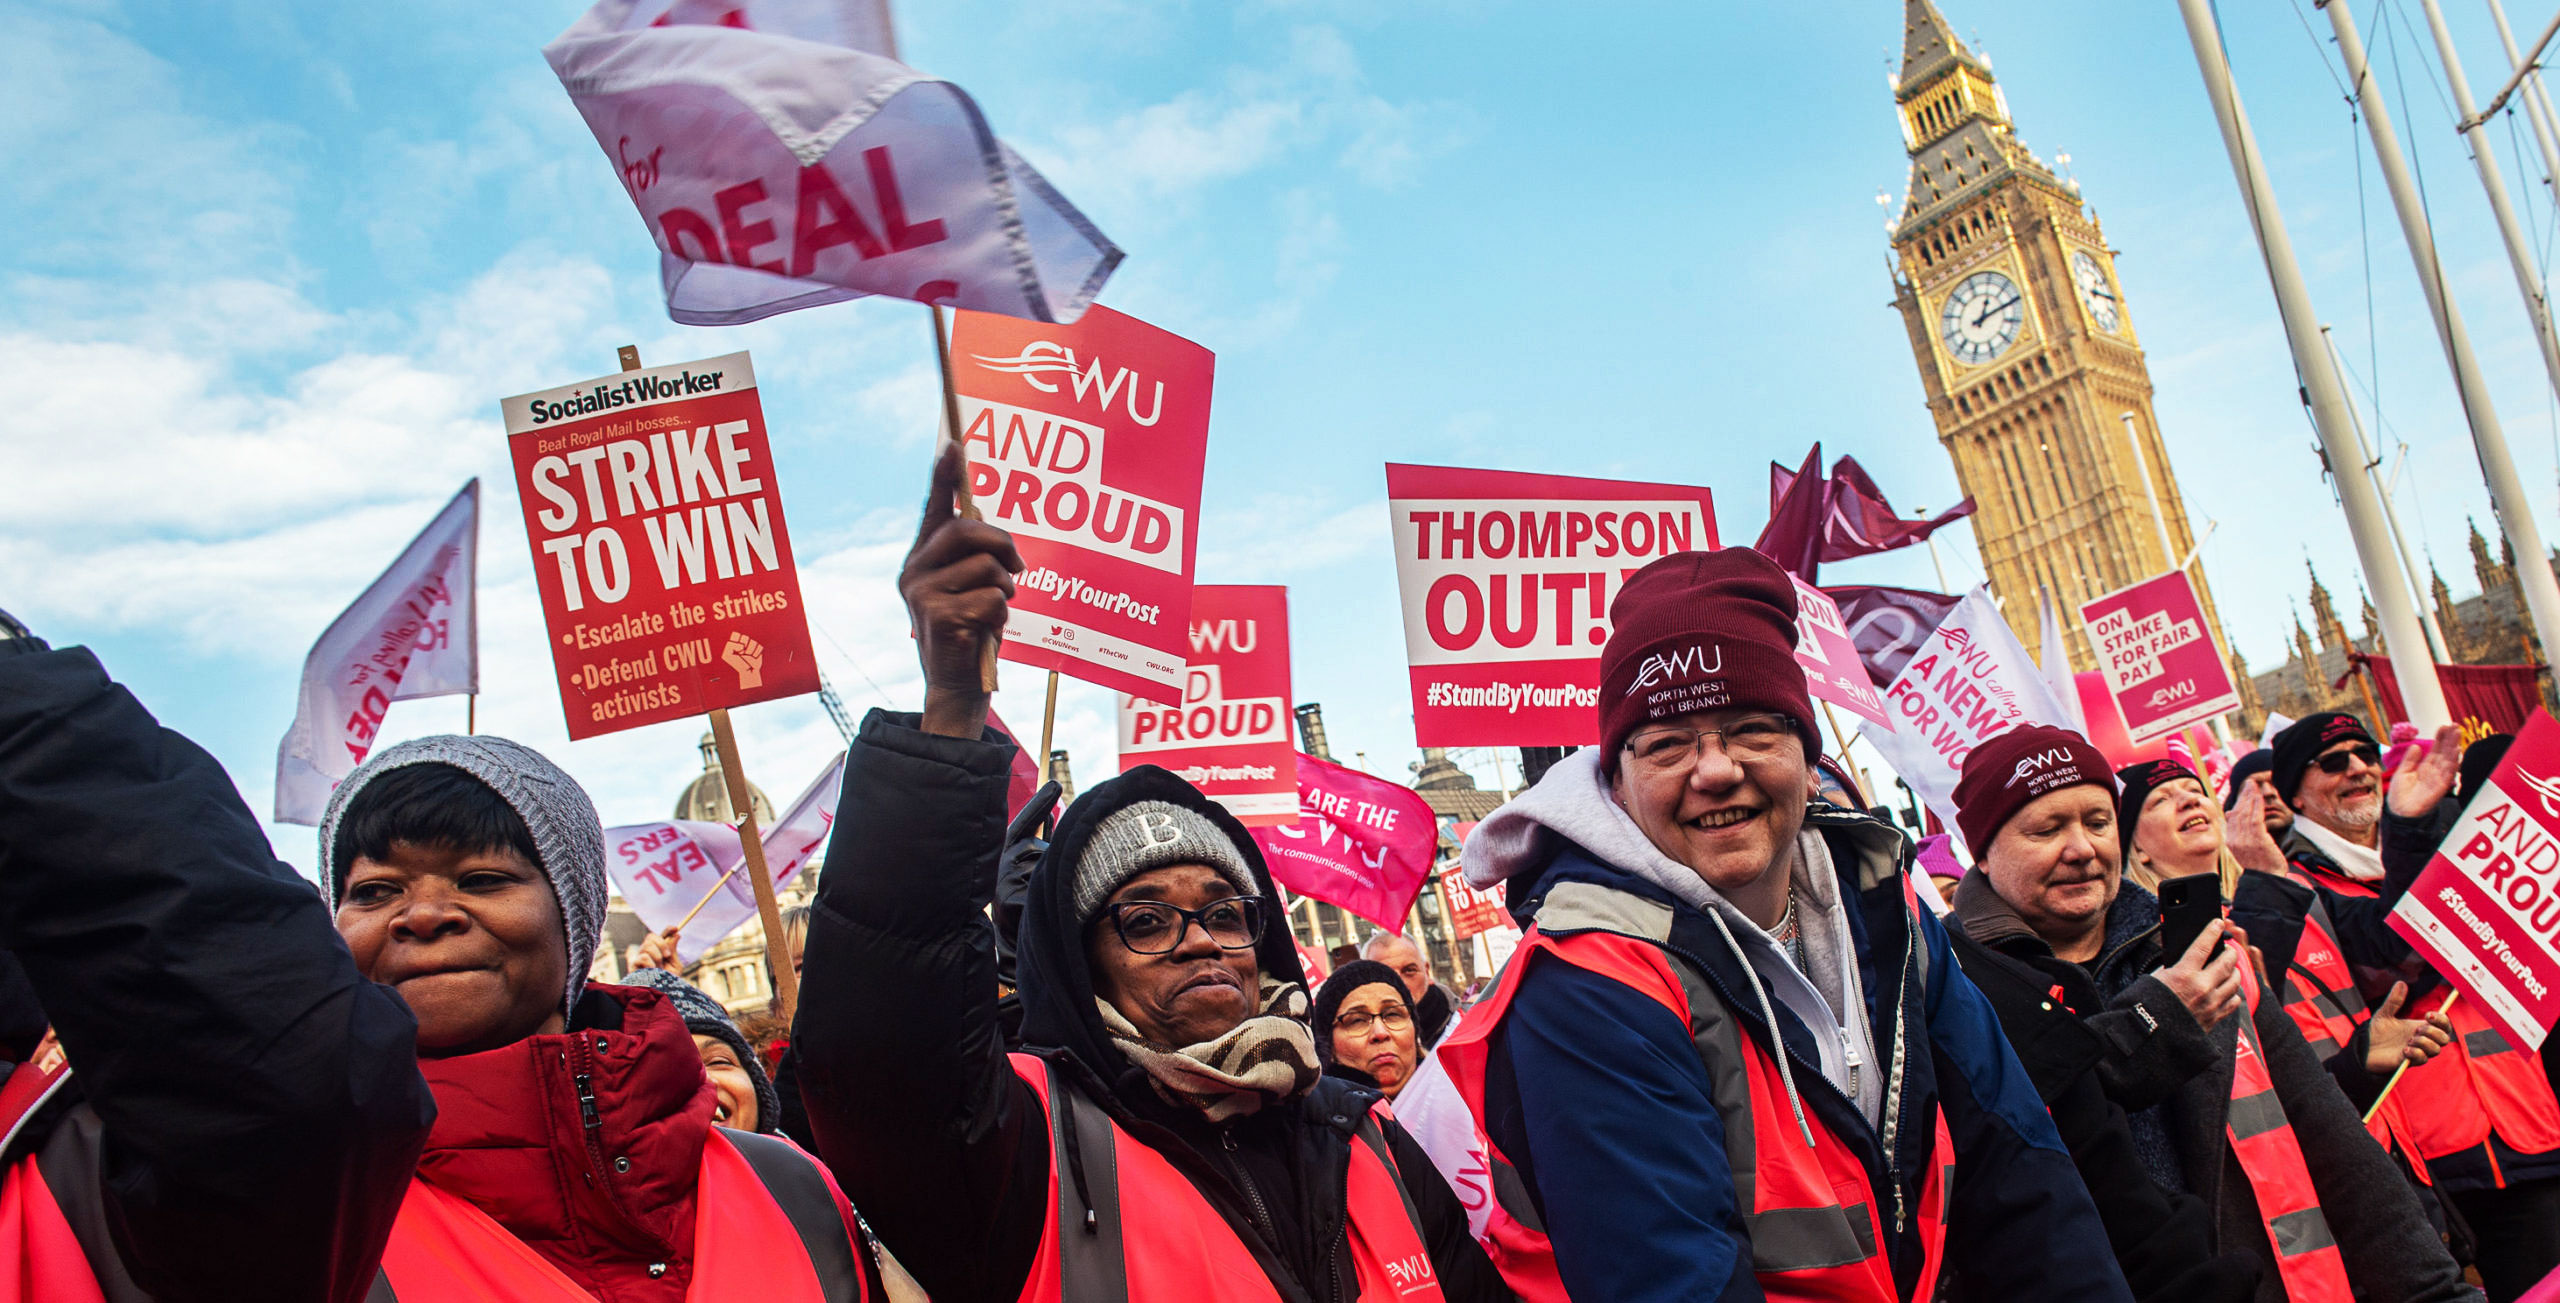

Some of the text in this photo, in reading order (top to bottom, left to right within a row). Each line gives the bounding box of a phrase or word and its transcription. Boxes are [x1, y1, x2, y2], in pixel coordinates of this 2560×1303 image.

[658, 144, 948, 277] DEAL
[973, 341, 1164, 427] CWU
[538, 415, 691, 454] Beat Royal Mail bosses...
[962, 408, 1091, 475] AND
[532, 419, 762, 533] STRIKE
[954, 460, 1171, 555] PROUD
[543, 526, 631, 612] TO
[643, 498, 780, 591] WIN
[1409, 510, 1692, 560] THOMPSON
[575, 588, 788, 651] Escalate the strikes
[1425, 572, 1607, 651] OUT!
[2096, 614, 2124, 636] ON
[1189, 619, 1256, 654] WU
[2104, 617, 2163, 653] STRIKE
[2112, 625, 2191, 670] FOR FAIR
[583, 638, 713, 690] Defend CWU
[1146, 661, 1175, 675] CWU.ORG
[1629, 645, 1721, 692] CWU
[2120, 660, 2152, 686] PAY
[591, 681, 682, 722] activists
[1648, 681, 1725, 705] NORTH WEST
[1649, 706, 1666, 719] NO
[1678, 693, 1731, 712] BRANCH
[1886, 677, 1939, 735] FOR
[1912, 653, 2010, 741] A NEW
[1986, 680, 2022, 718] calling
[2147, 678, 2196, 707] CWU
[1132, 703, 1274, 745] PROUD
[2008, 746, 2073, 784] CWU
[2027, 765, 2078, 788] NORTH WEST
[2049, 773, 2082, 788] BRANCH
[1306, 788, 1400, 831] ARE THE
[1135, 812, 1182, 852] B
[2474, 803, 2560, 875] AND
[1268, 842, 1283, 855] The
[1284, 848, 1358, 880] communications
[2437, 887, 2548, 1001] #StandByYourPost
